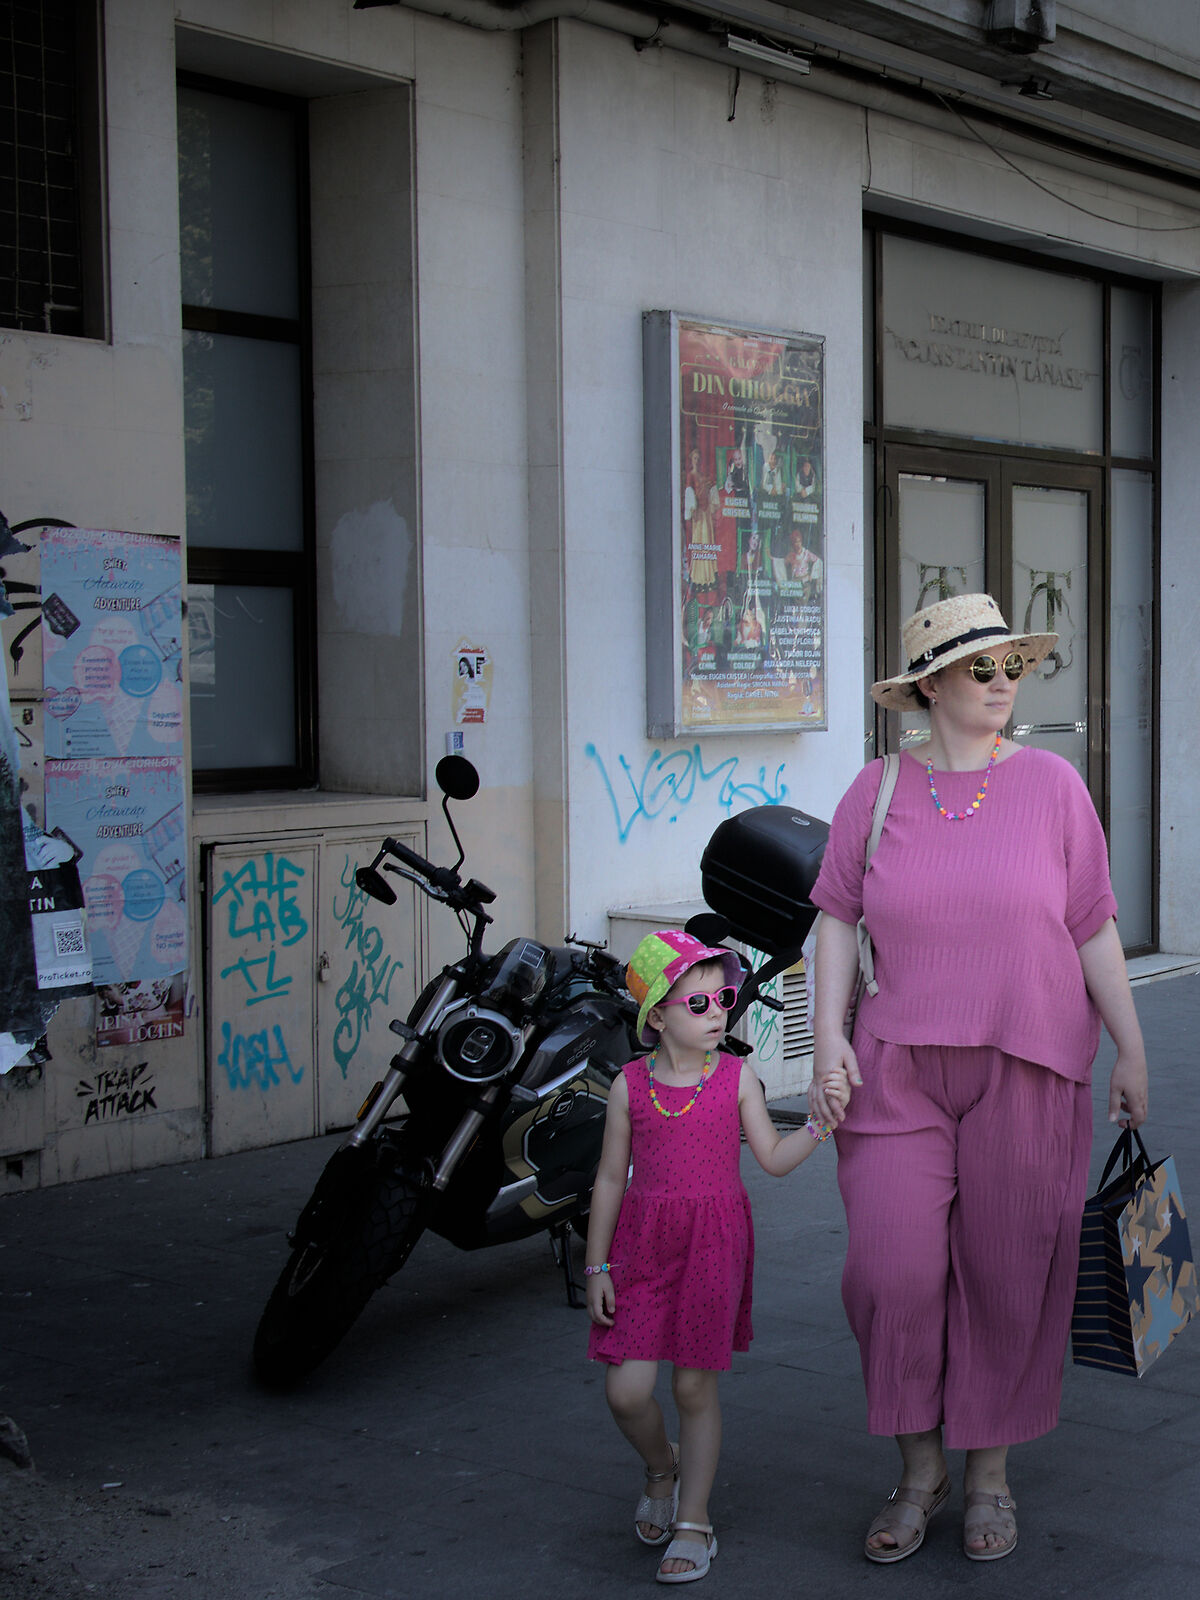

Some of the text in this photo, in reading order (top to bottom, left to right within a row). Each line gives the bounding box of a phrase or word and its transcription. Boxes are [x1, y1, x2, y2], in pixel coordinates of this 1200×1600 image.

[692, 372, 725, 396] DIN
[103, 558, 128, 571] SWEET
[94, 597, 142, 612] ADVENTURE
[51, 760, 99, 772] MUZEUL
[105, 785, 129, 798] SWEET
[96, 823, 143, 840] ADVENTURE
[212, 852, 305, 905] THE
[229, 895, 308, 946] LAB
[157, 941, 167, 950] NO
[38, 970, 92, 982] ProTicket.ro
[95, 1062, 148, 1095] TRAP
[85, 1087, 157, 1125] ATTACK
